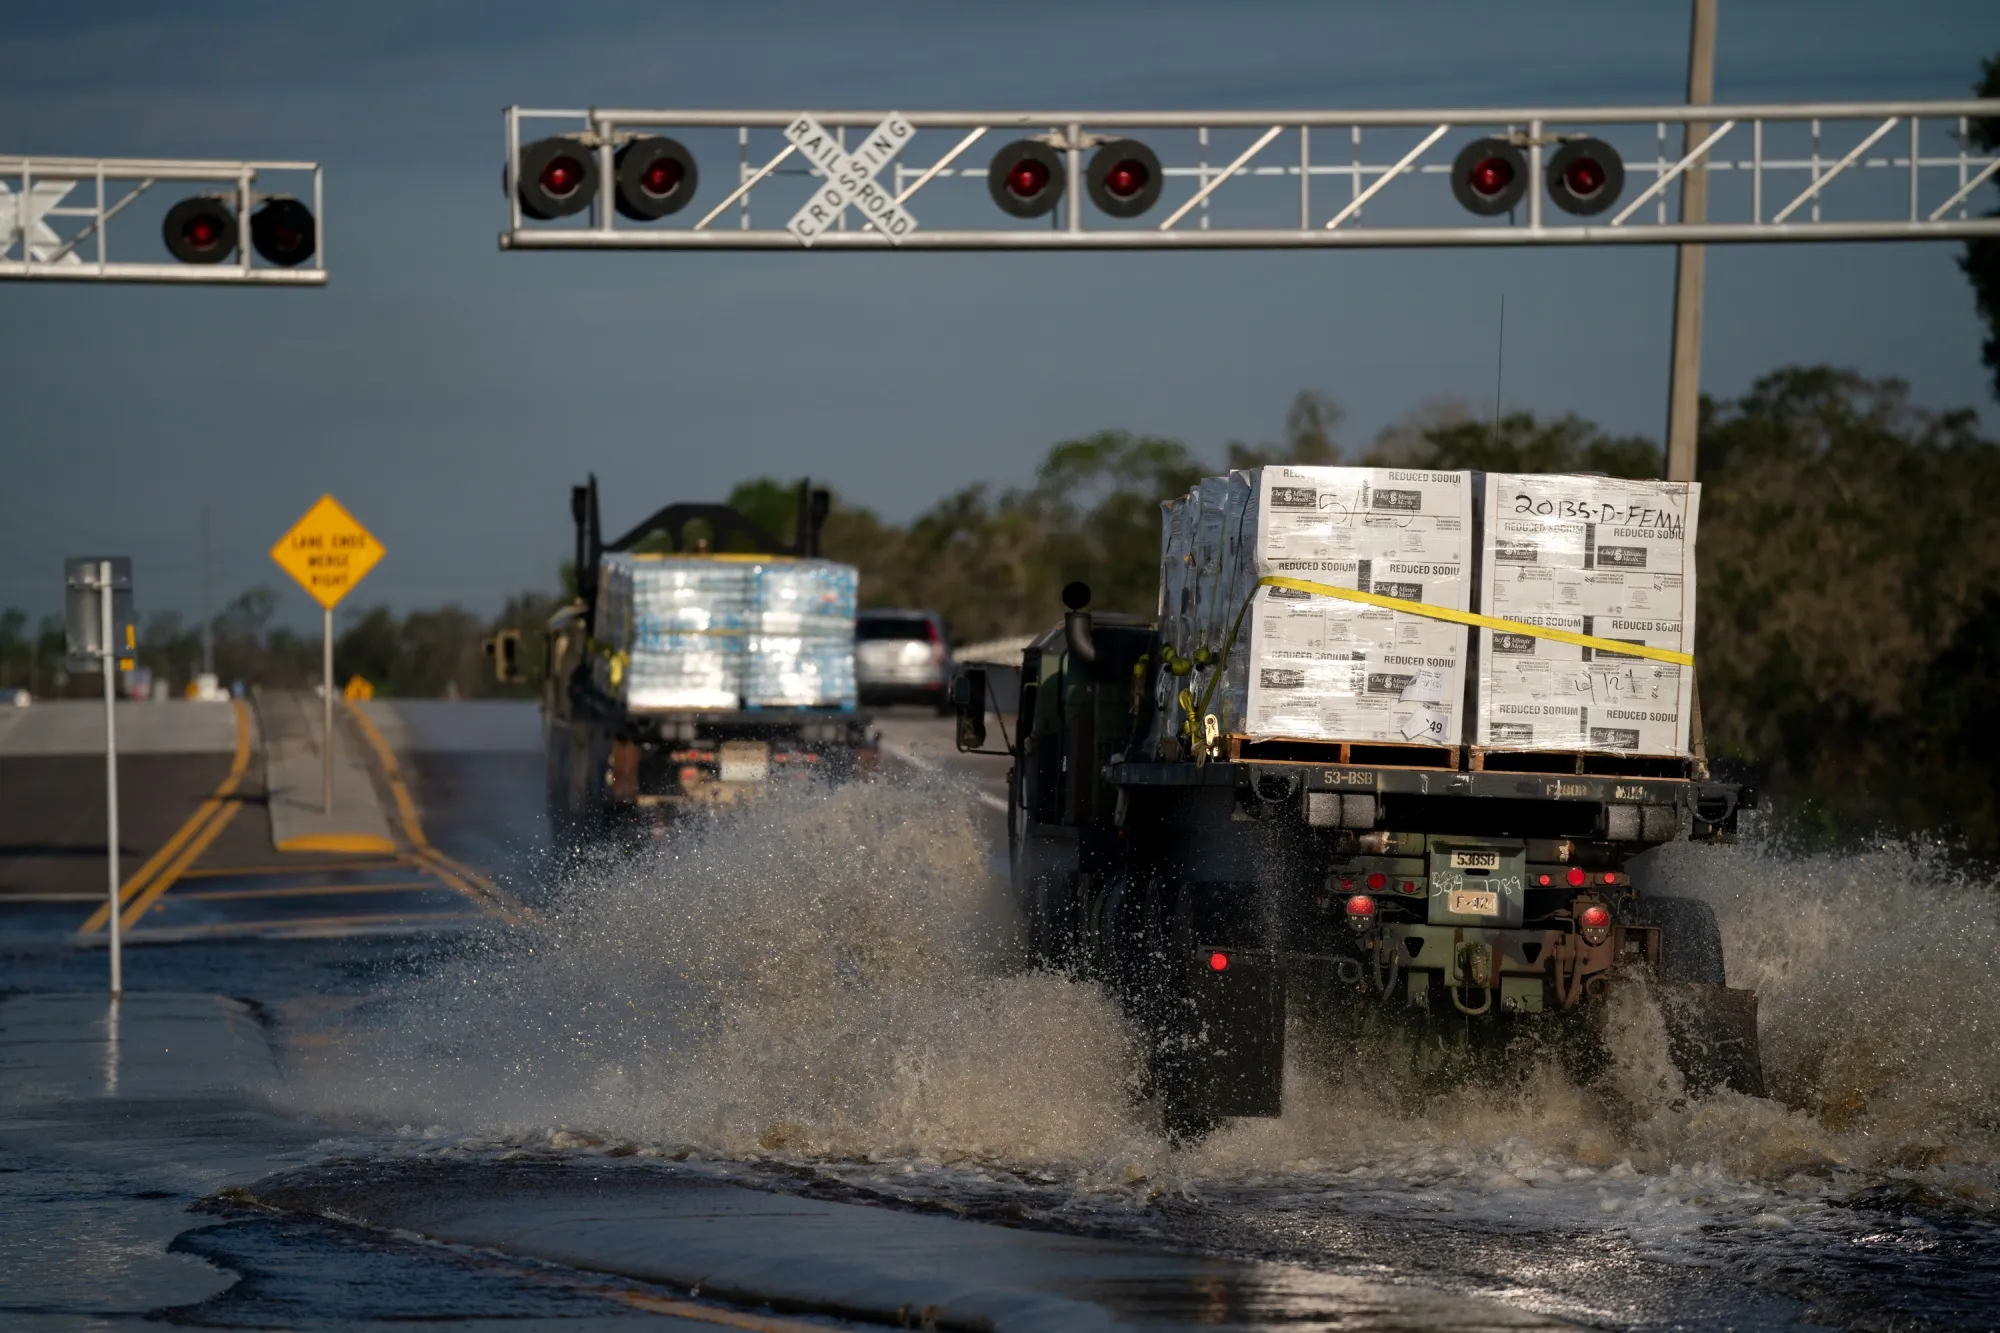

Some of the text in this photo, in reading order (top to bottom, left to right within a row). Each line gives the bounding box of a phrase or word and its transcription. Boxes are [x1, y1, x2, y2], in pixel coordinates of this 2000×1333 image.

[797, 120, 907, 236] CROSSING
[1389, 471, 1428, 482] REDUCED
[1614, 528, 1655, 538] REDUCED
[1279, 562, 1356, 572] REDUCED SODIUM
[1390, 564, 1430, 574] REDUCED
[1545, 617, 1581, 627] SODIUM
[1612, 620, 1653, 631] REDUCED
[1384, 656, 1455, 668] REDUCED SODIU
[1500, 704, 1578, 716] REDUCED SODIUM
[1606, 710, 1647, 720] REDUCED
[1426, 719, 1443, 734] 49
[1324, 771, 1372, 785] 53-BSB
[1457, 852, 1496, 866] 53BSB
